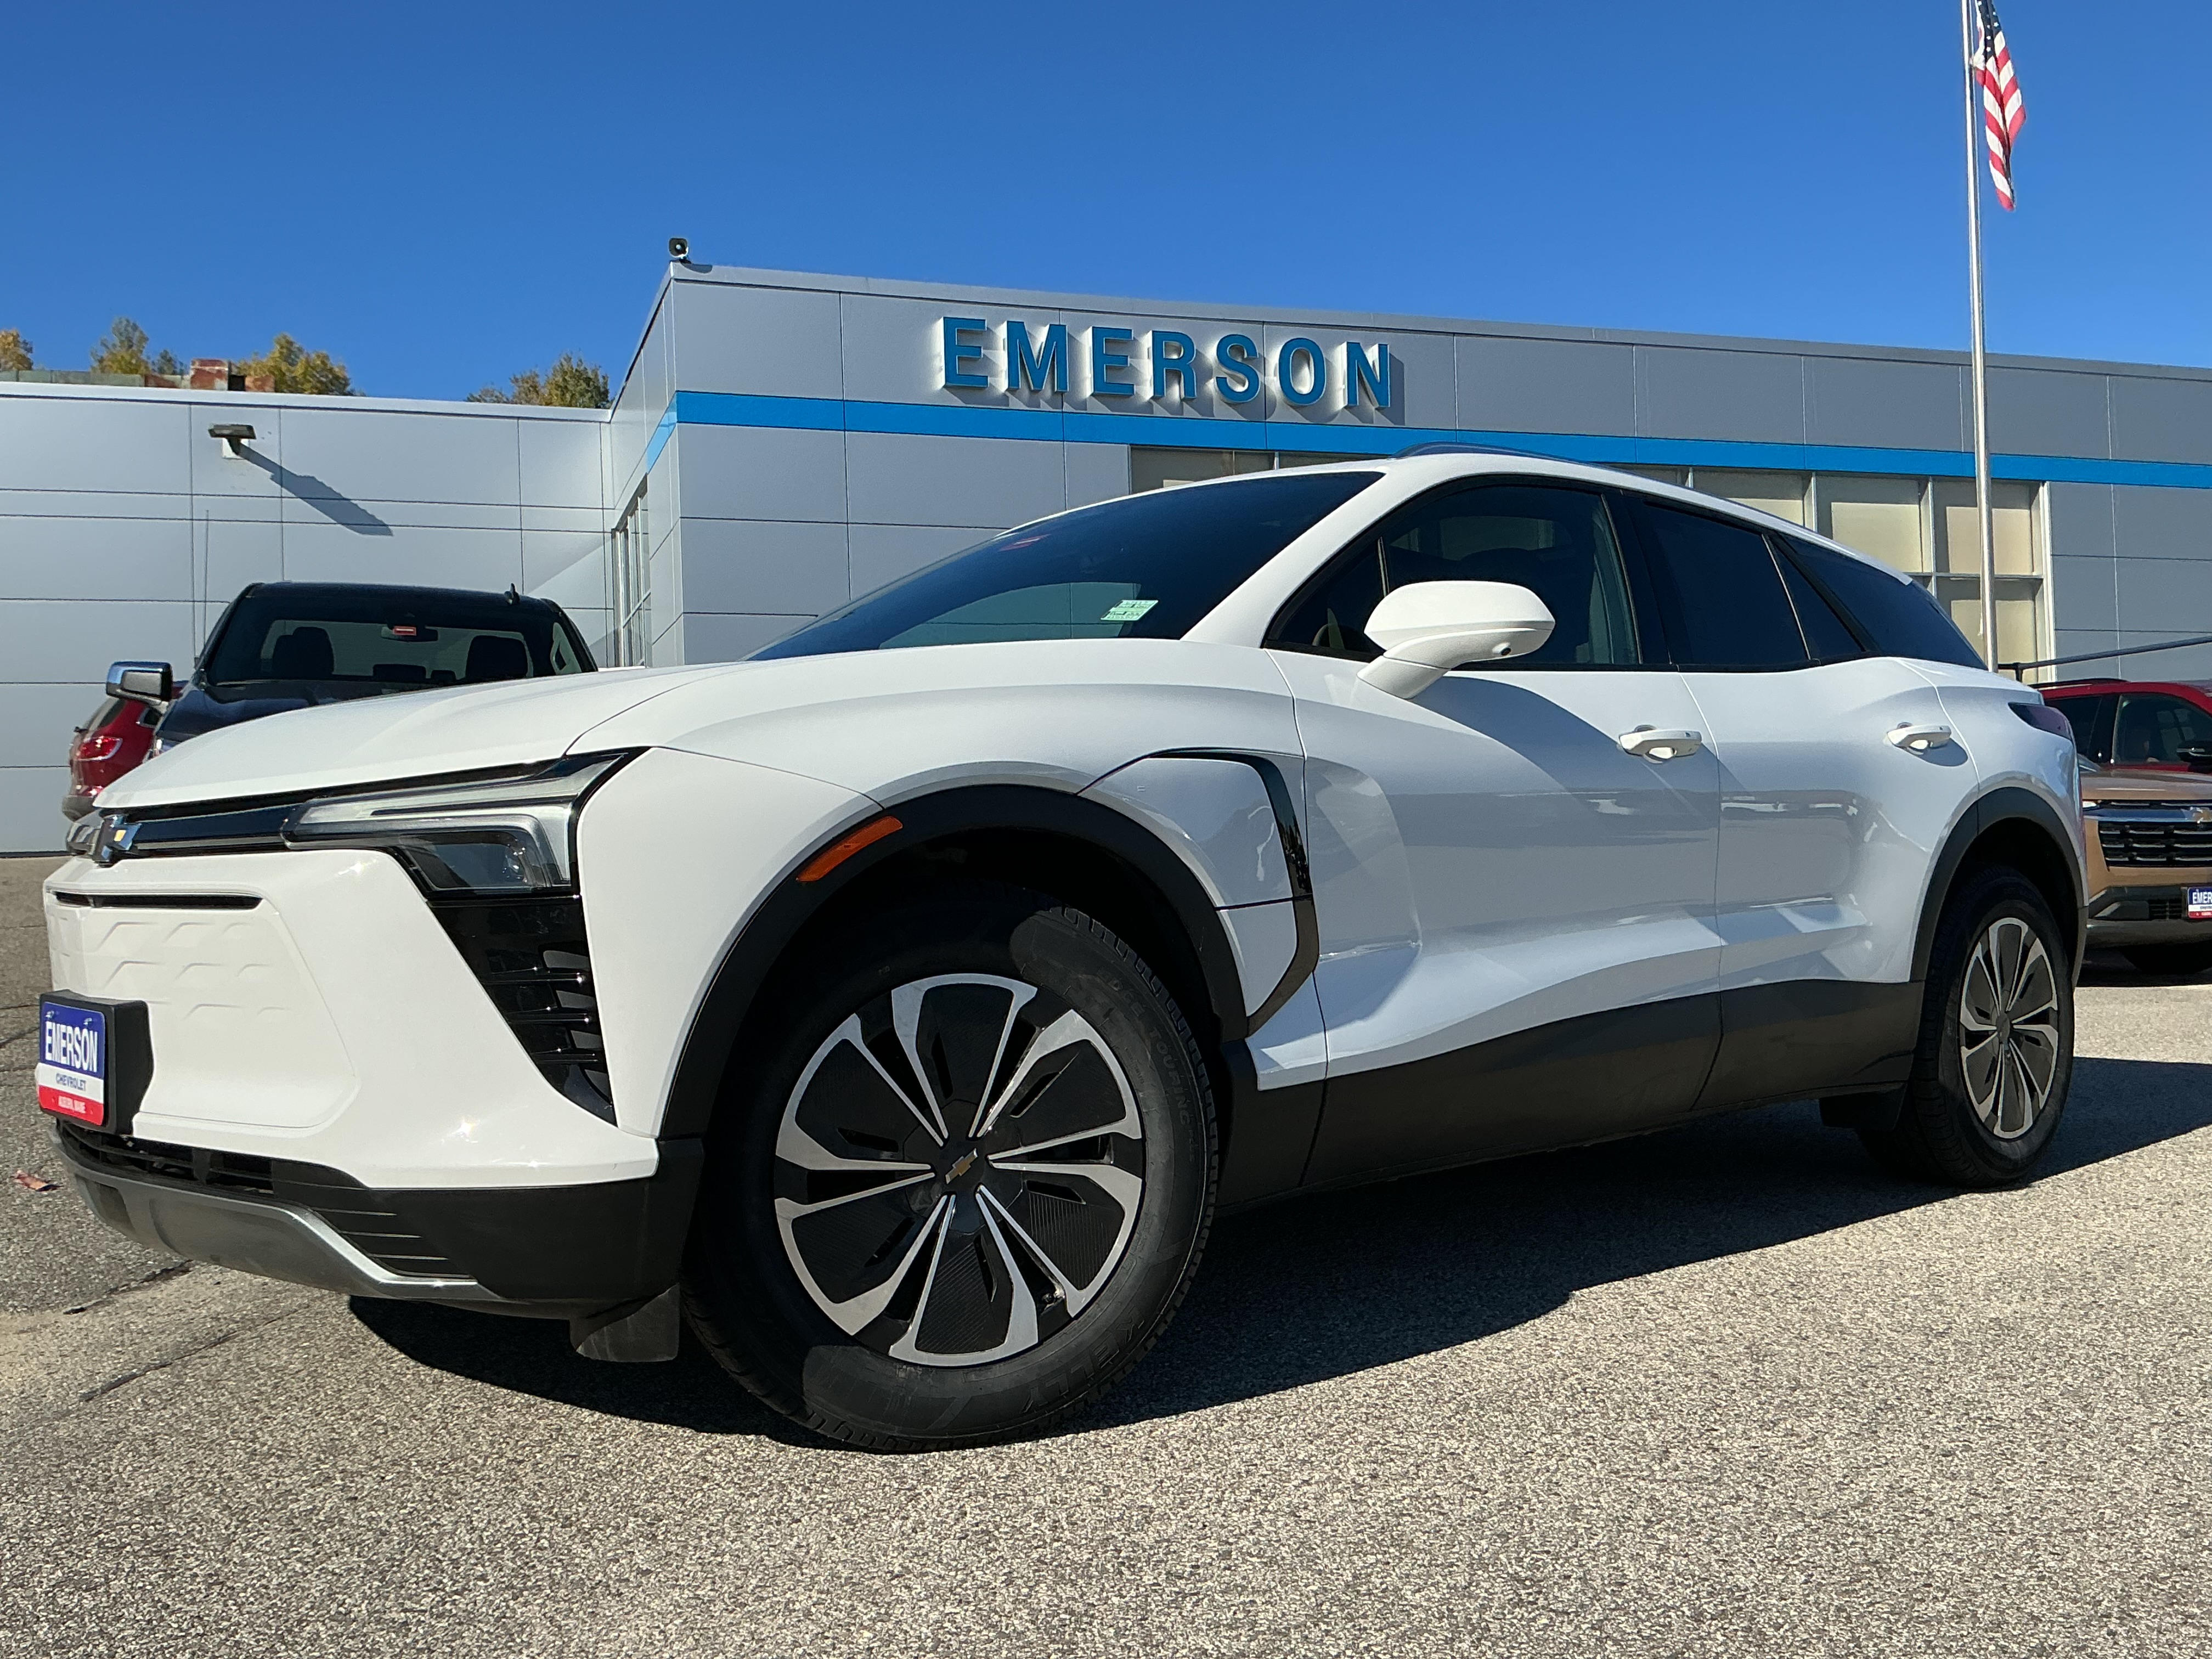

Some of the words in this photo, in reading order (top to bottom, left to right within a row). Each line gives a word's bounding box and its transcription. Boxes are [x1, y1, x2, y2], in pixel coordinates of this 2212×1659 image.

[942, 317, 1391, 409] EMERSON
[45, 1021, 98, 1073] EMERSON
[56, 1073, 87, 1091] CHEVROLET
[1149, 1026, 1190, 1126] TOURING
[1020, 1306, 1145, 1414] KELLY
